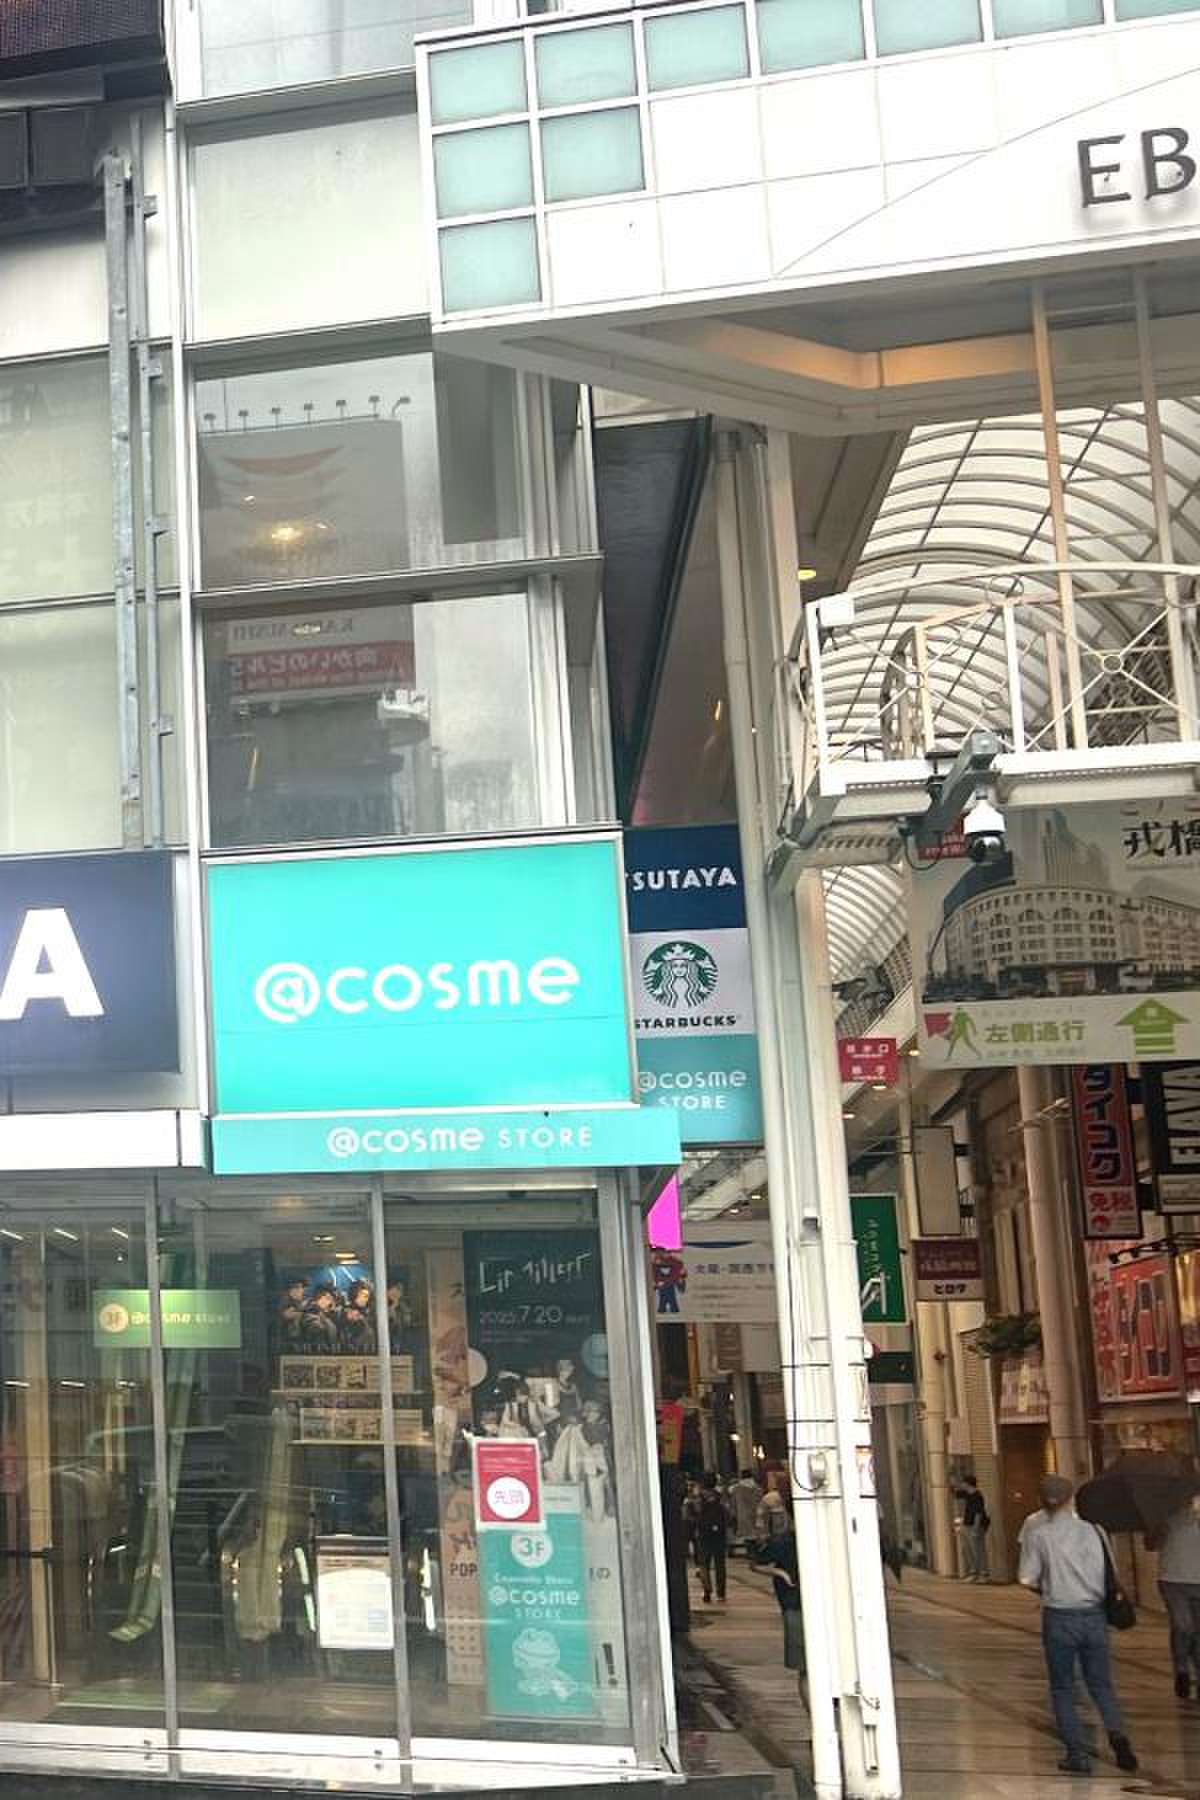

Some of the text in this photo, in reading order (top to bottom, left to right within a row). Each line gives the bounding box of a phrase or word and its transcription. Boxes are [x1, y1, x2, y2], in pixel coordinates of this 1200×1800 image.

[1077, 127, 1197, 209] EB
[626, 867, 737, 891] SUTAYA
[252, 957, 581, 1023] @cosme
[634, 1015, 738, 1030] STARBUCKS
[984, 1019, 1087, 1043] 左側通行
[638, 1070, 747, 1092] @cosme
[658, 1094, 726, 1111] STORE
[326, 1126, 592, 1158] @cosme STORE
[487, 1585, 581, 1607] @cosme
